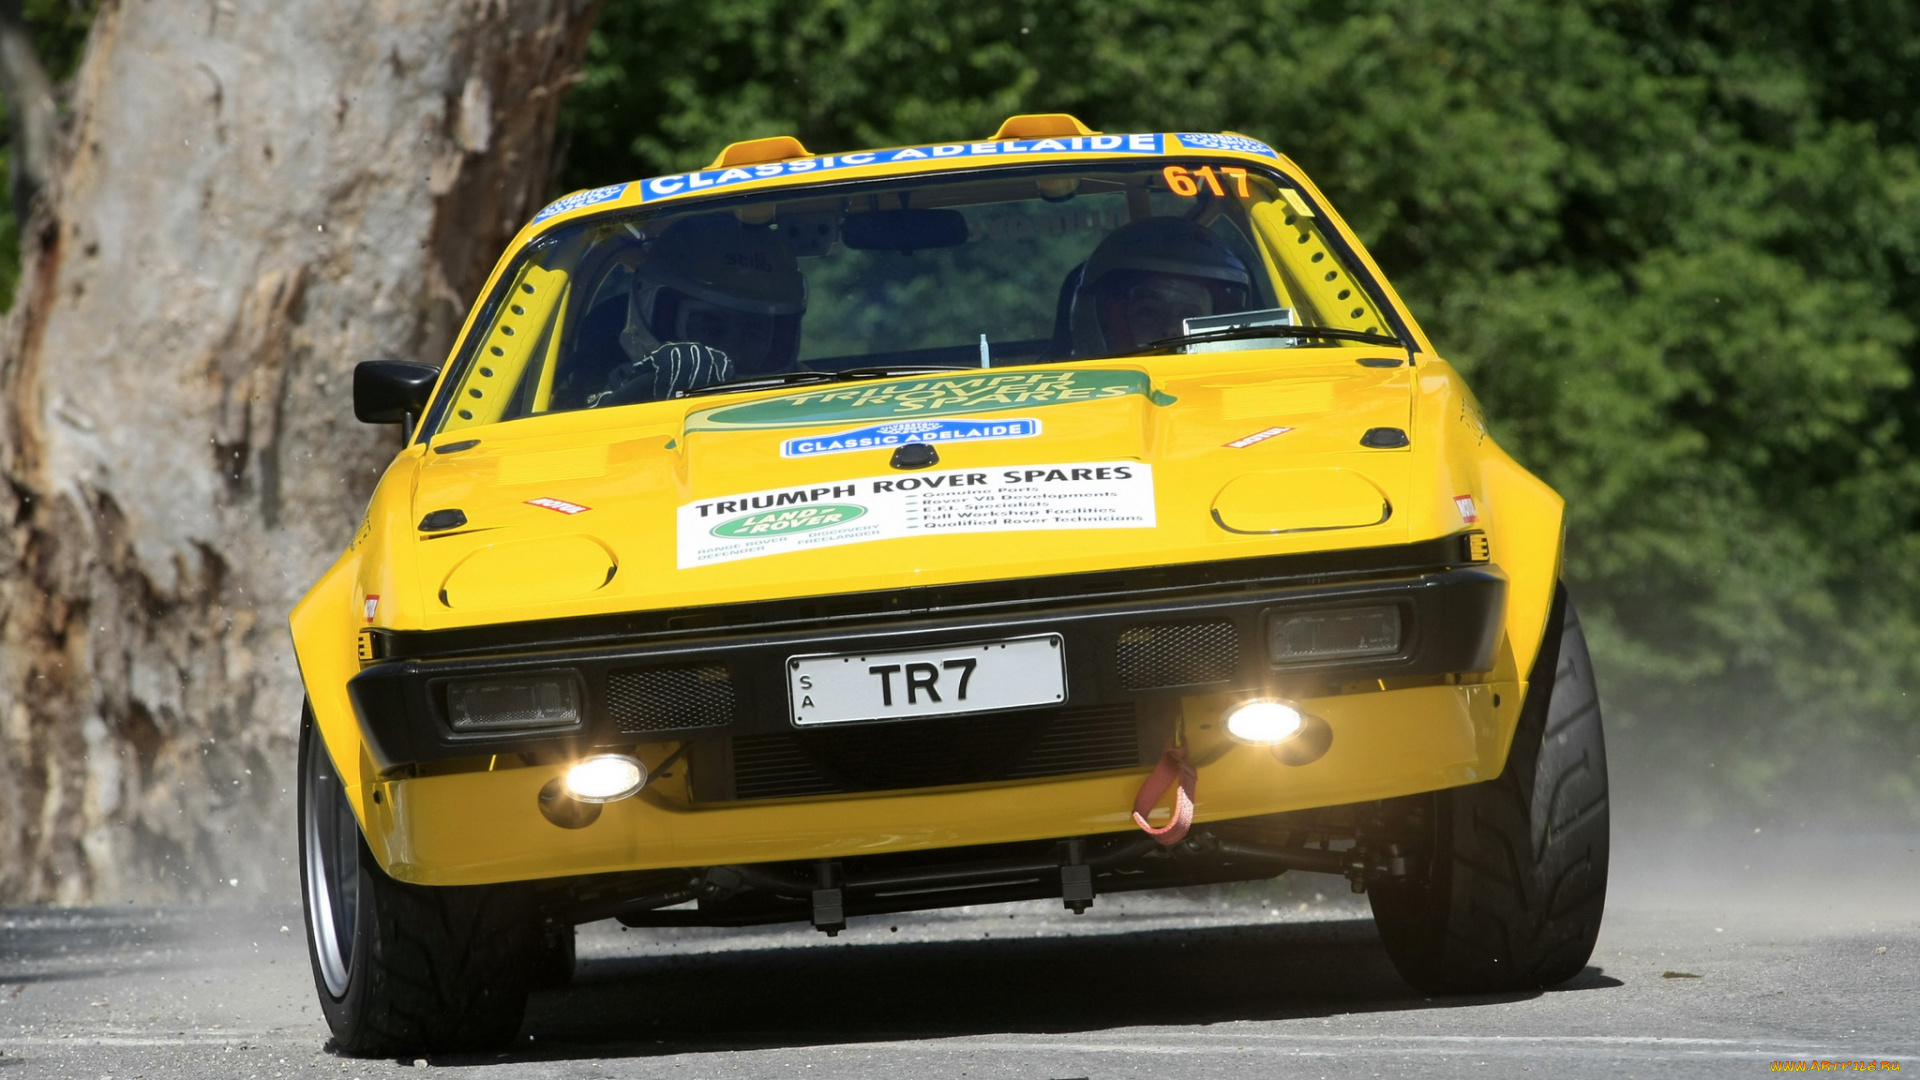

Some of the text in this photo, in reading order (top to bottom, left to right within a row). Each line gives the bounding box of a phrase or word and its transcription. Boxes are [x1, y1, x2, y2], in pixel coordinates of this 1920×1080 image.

[649, 152, 876, 195] CLASSIC
[891, 133, 1156, 160] ADELAIDE
[1163, 165, 1251, 198] 617
[785, 371, 1077, 406] TRIUMPH
[851, 380, 1077, 407] ROVER
[893, 385, 1131, 412] SPARES
[798, 423, 1022, 453] CLASSIC ADELAIDE
[695, 466, 1133, 518] TRIUMPH ROVER SPARES
[923, 489, 992, 498] Genuine
[1001, 492, 1118, 500] Developments
[957, 510, 1039, 518] Workshop
[964, 502, 1050, 510] Specialists
[924, 519, 998, 528] Qualified
[1053, 515, 1143, 523] Technicians
[797, 530, 881, 545] FREELANDER
[808, 524, 881, 538] DISCOVERY
[697, 536, 788, 554] RANGE ROVER
[697, 546, 765, 560] DEFENDER
[868, 657, 978, 707] TR7
